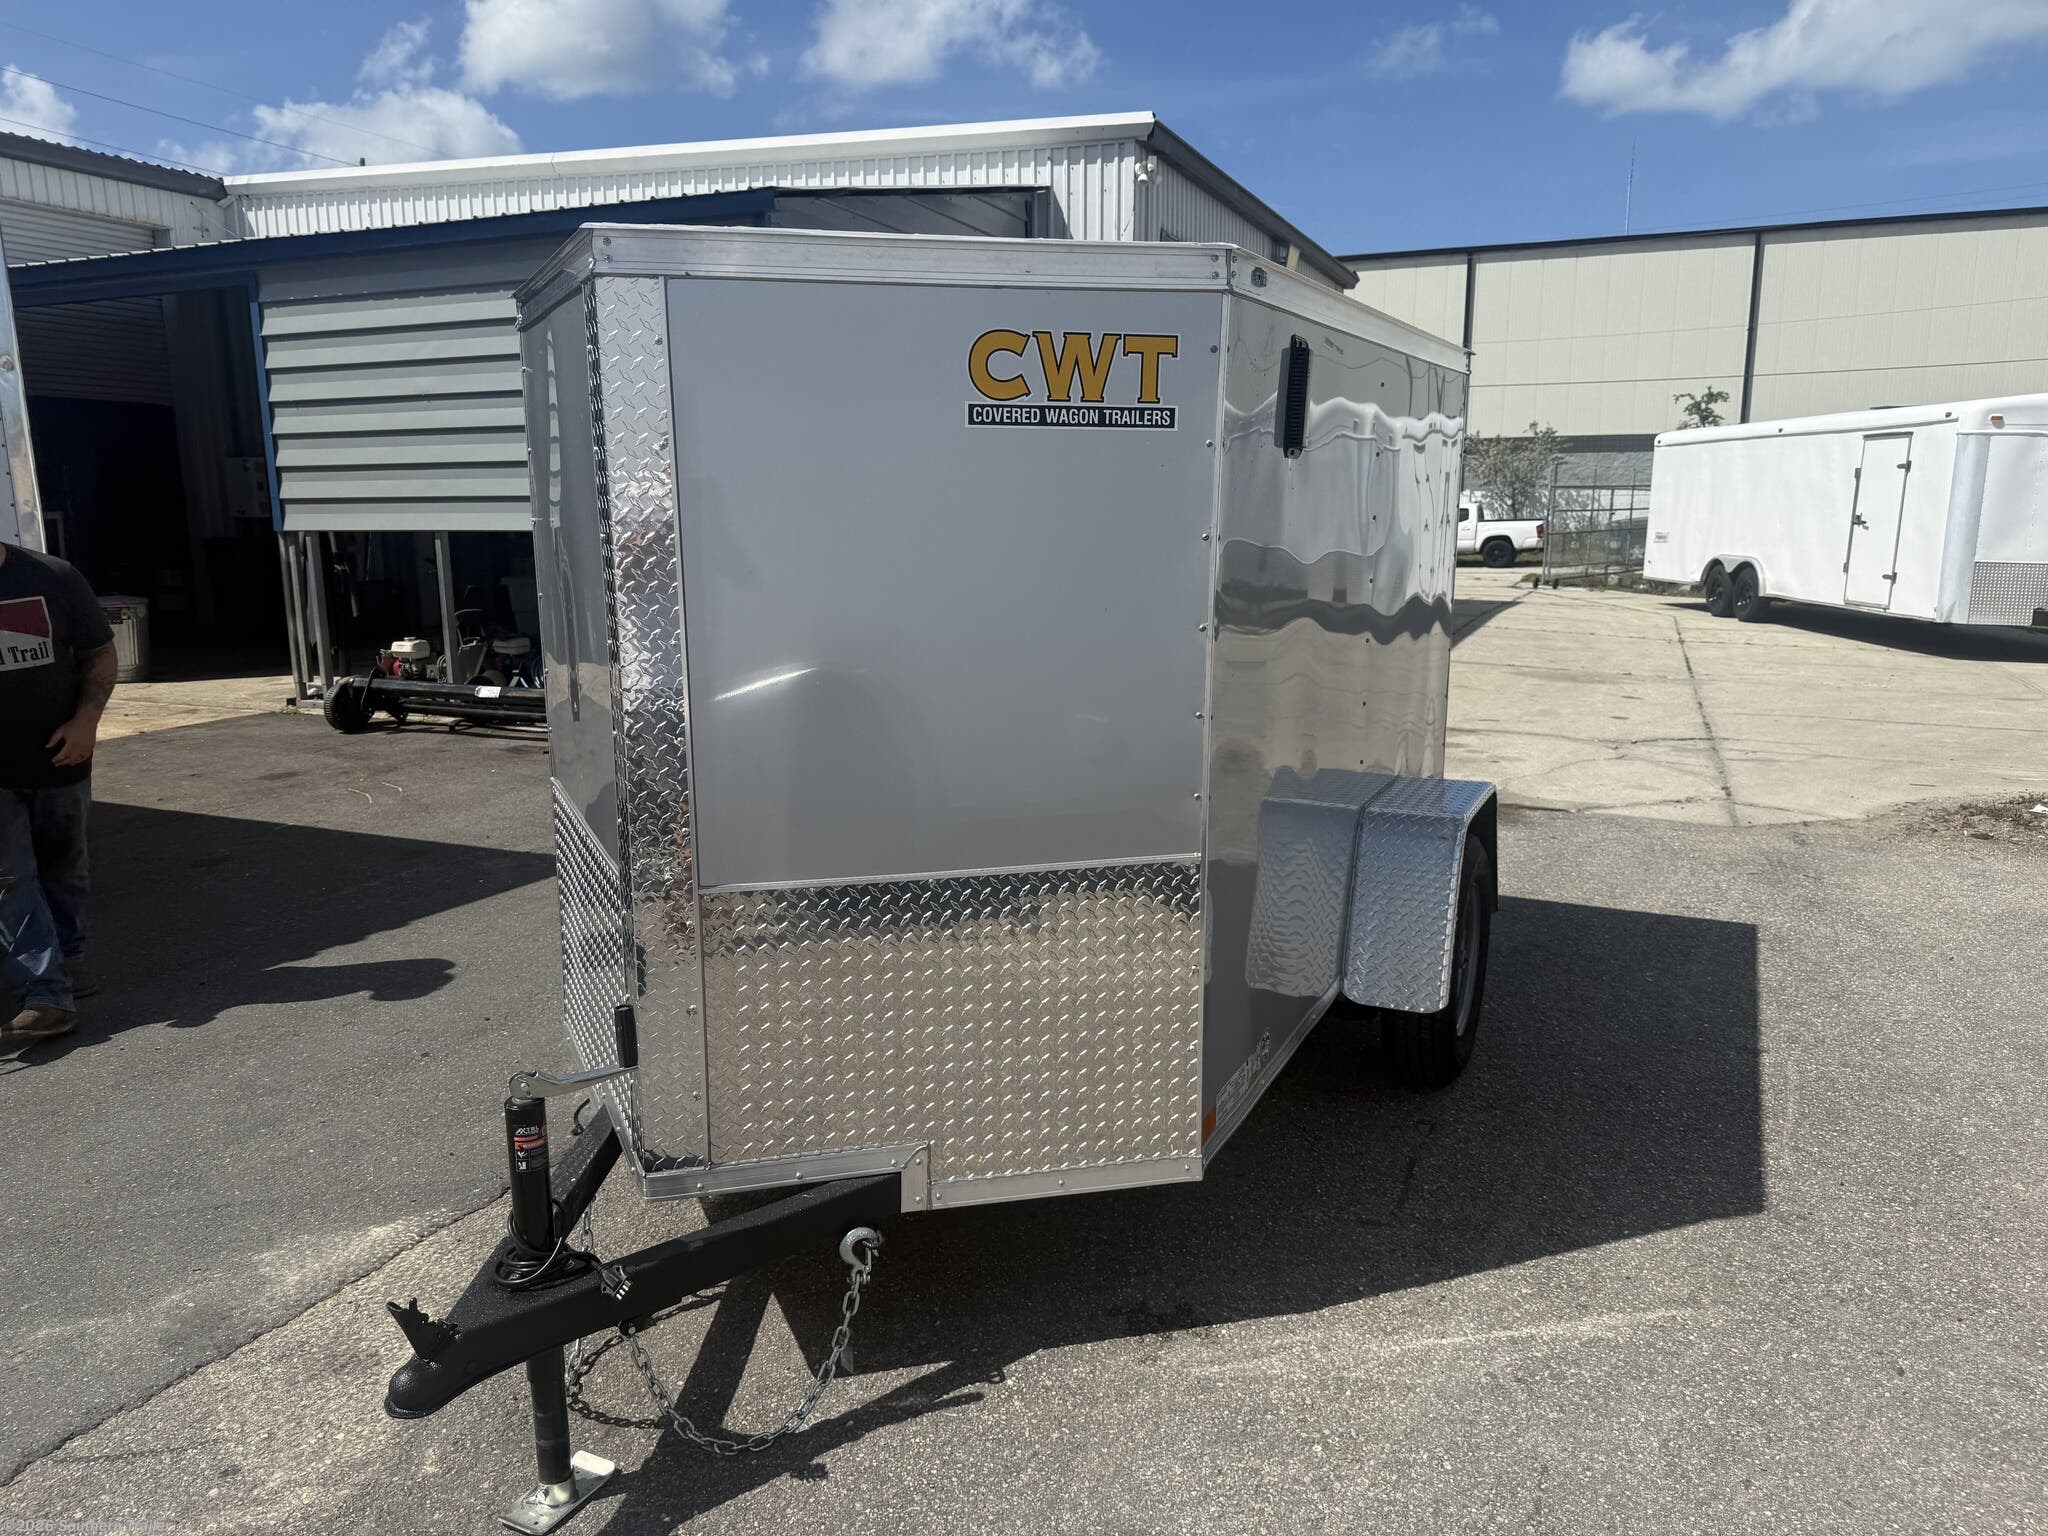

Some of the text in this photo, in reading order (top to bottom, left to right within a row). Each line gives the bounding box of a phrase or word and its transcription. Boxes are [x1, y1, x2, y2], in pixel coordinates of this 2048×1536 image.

[968, 328, 1179, 404] CWT
[973, 407, 1171, 426] COVERED WAGON TRAILERS
[7, 641, 49, 663] Trail
